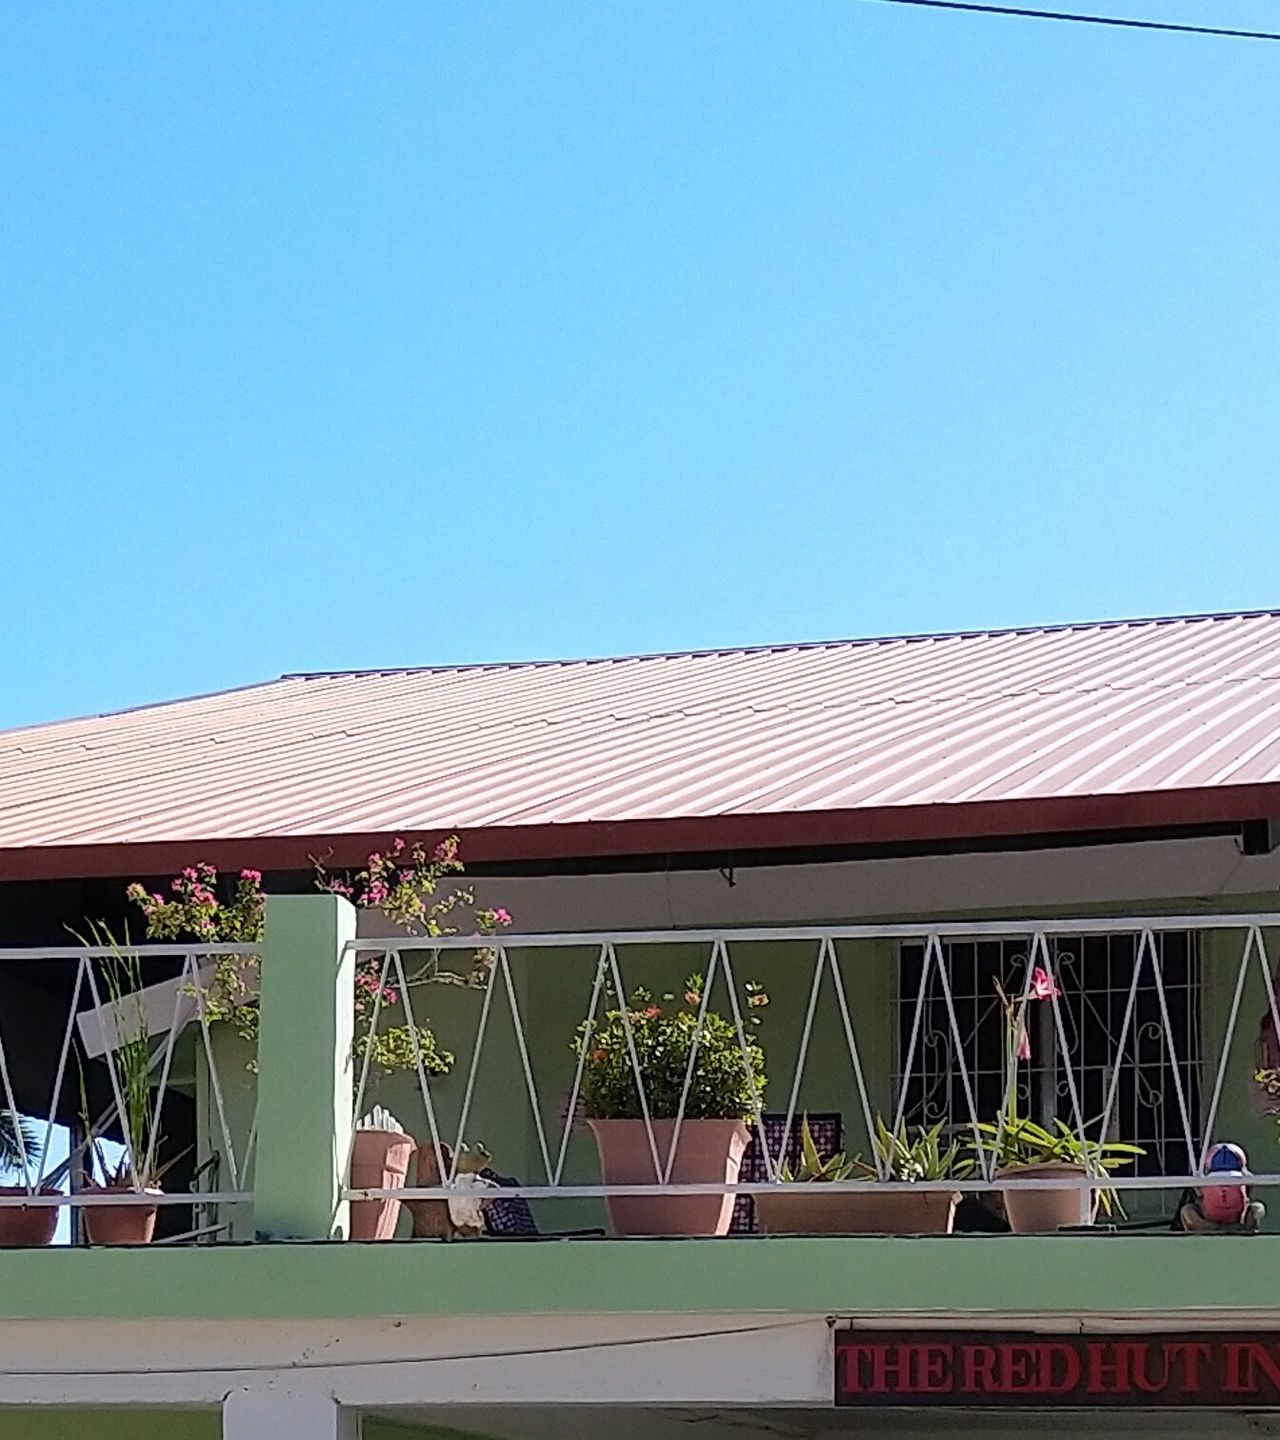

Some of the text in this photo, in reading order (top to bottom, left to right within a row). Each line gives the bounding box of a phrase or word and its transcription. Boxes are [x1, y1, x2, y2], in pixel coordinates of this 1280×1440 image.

[837, 1342, 954, 1394] THE
[960, 1343, 1081, 1394] RED
[1085, 1343, 1213, 1394] HUT
